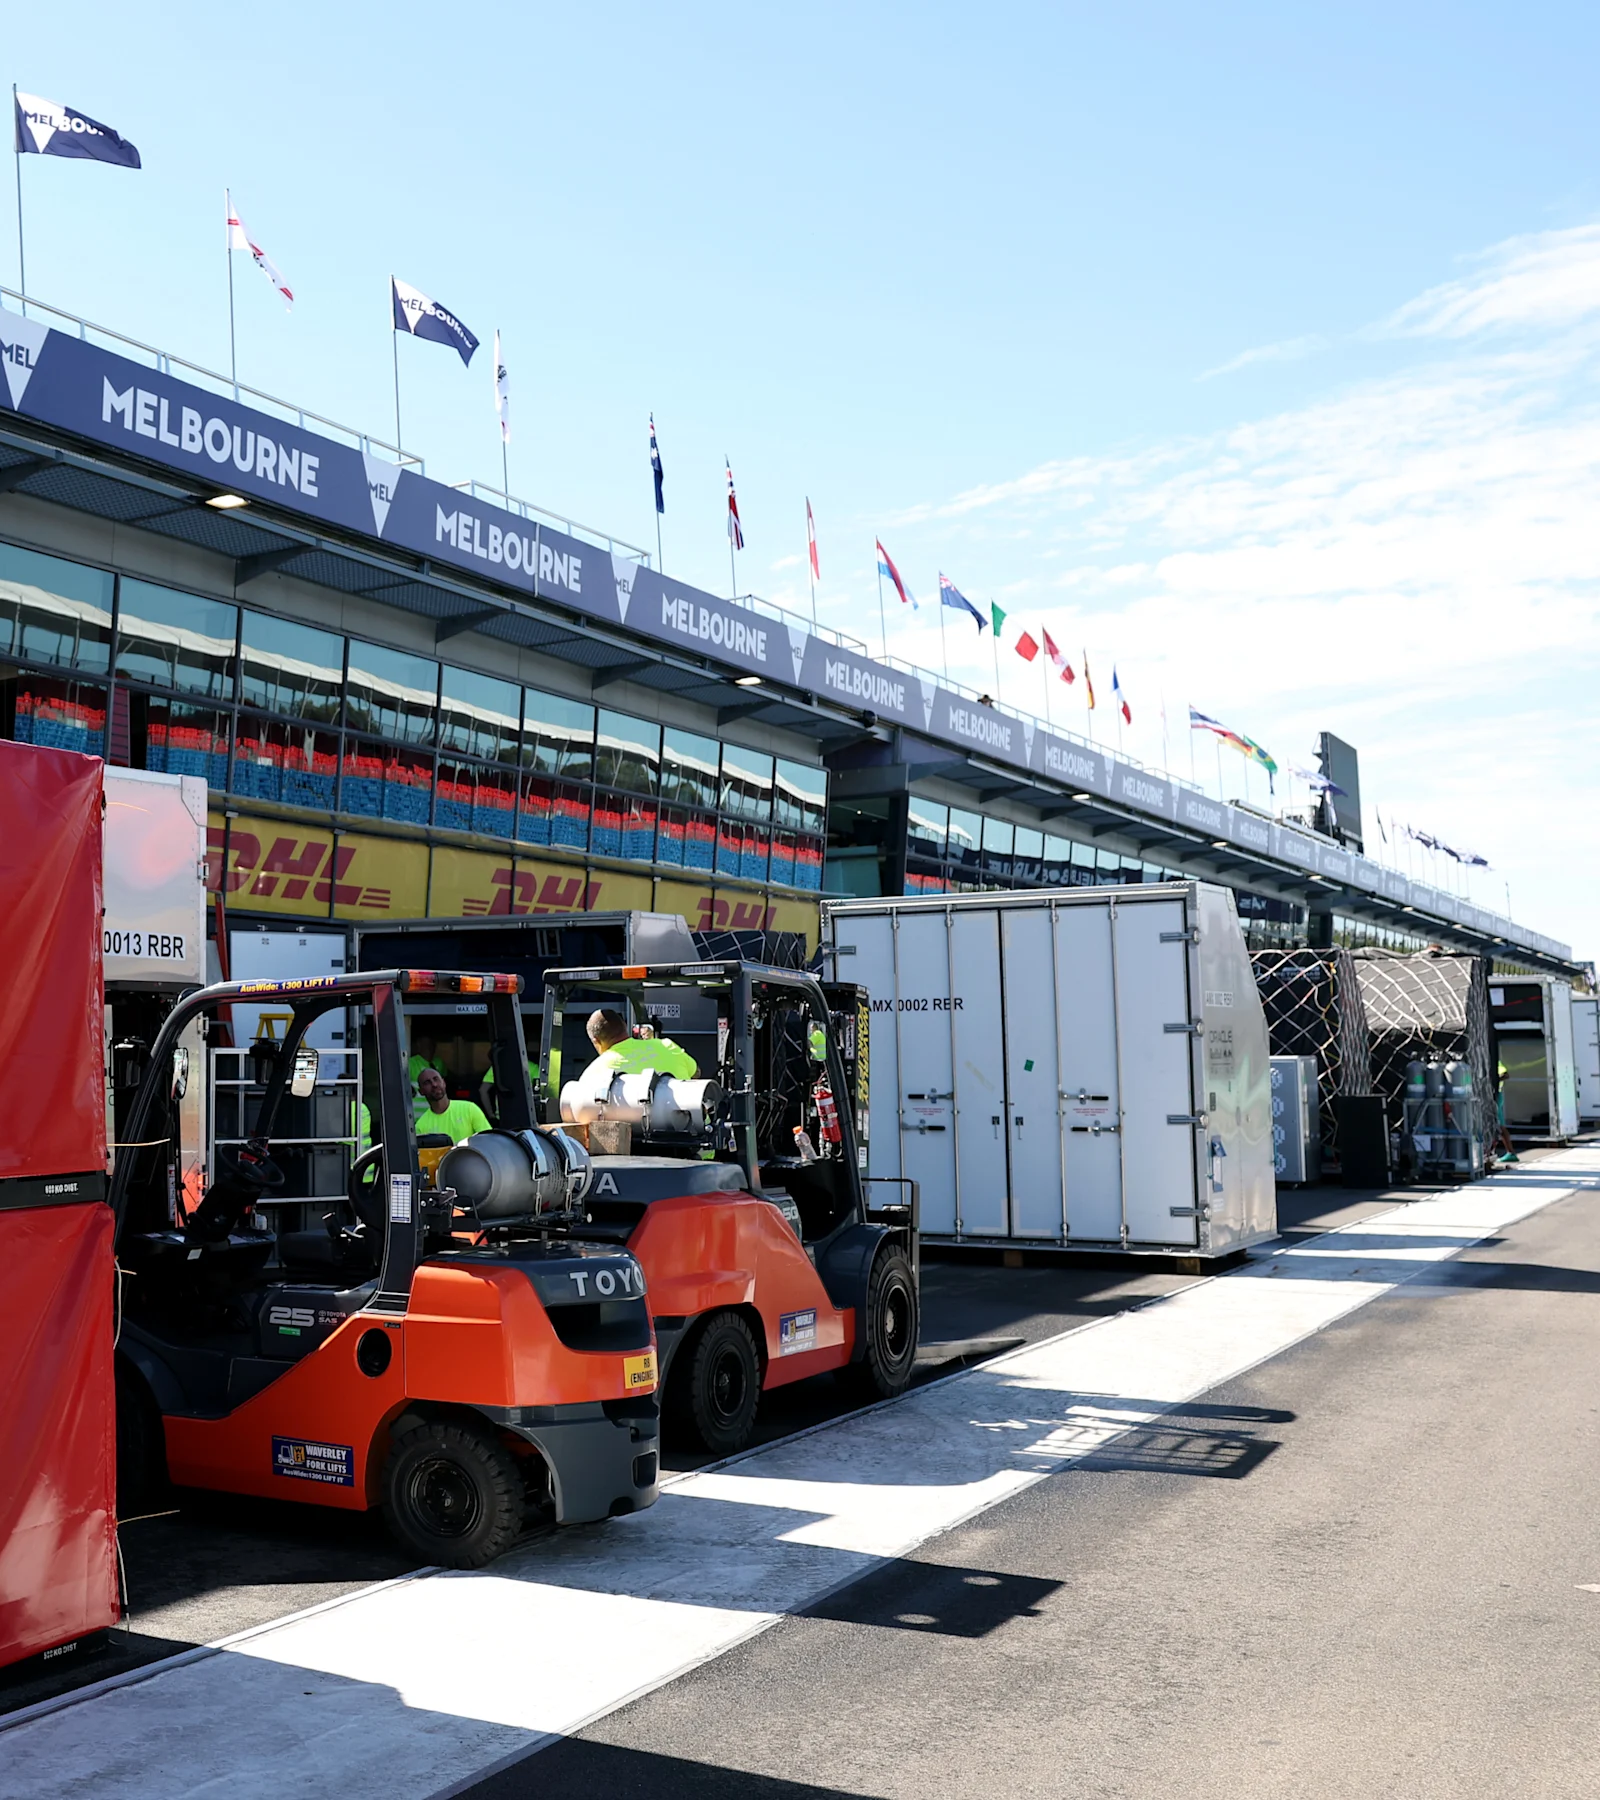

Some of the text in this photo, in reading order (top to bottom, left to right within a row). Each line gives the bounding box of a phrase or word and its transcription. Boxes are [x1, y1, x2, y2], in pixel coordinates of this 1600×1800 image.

[0, 338, 36, 371] MEL
[102, 375, 319, 497] MELBOURNE
[369, 481, 392, 504] MEL
[436, 503, 581, 593] MELBOURNE
[662, 593, 766, 662] MELBOURNE
[825, 658, 904, 712] MELBOURNE
[949, 706, 1011, 752] MELBOURNE
[1045, 744, 1095, 782] MELBOURNE
[1122, 775, 1163, 808] MELBOURNE
[204, 827, 363, 906] DHL
[104, 931, 184, 958] 0013 RBR
[240, 977, 335, 993] AusWide: 1300 LIFT IT
[898, 999, 928, 1011] 0002
[269, 1306, 315, 1327] 25
[326, 1310, 347, 1318] TOYOTA
[305, 1445, 347, 1461] WAVERLEY
[306, 1460, 347, 1474] FORK LIFTS
